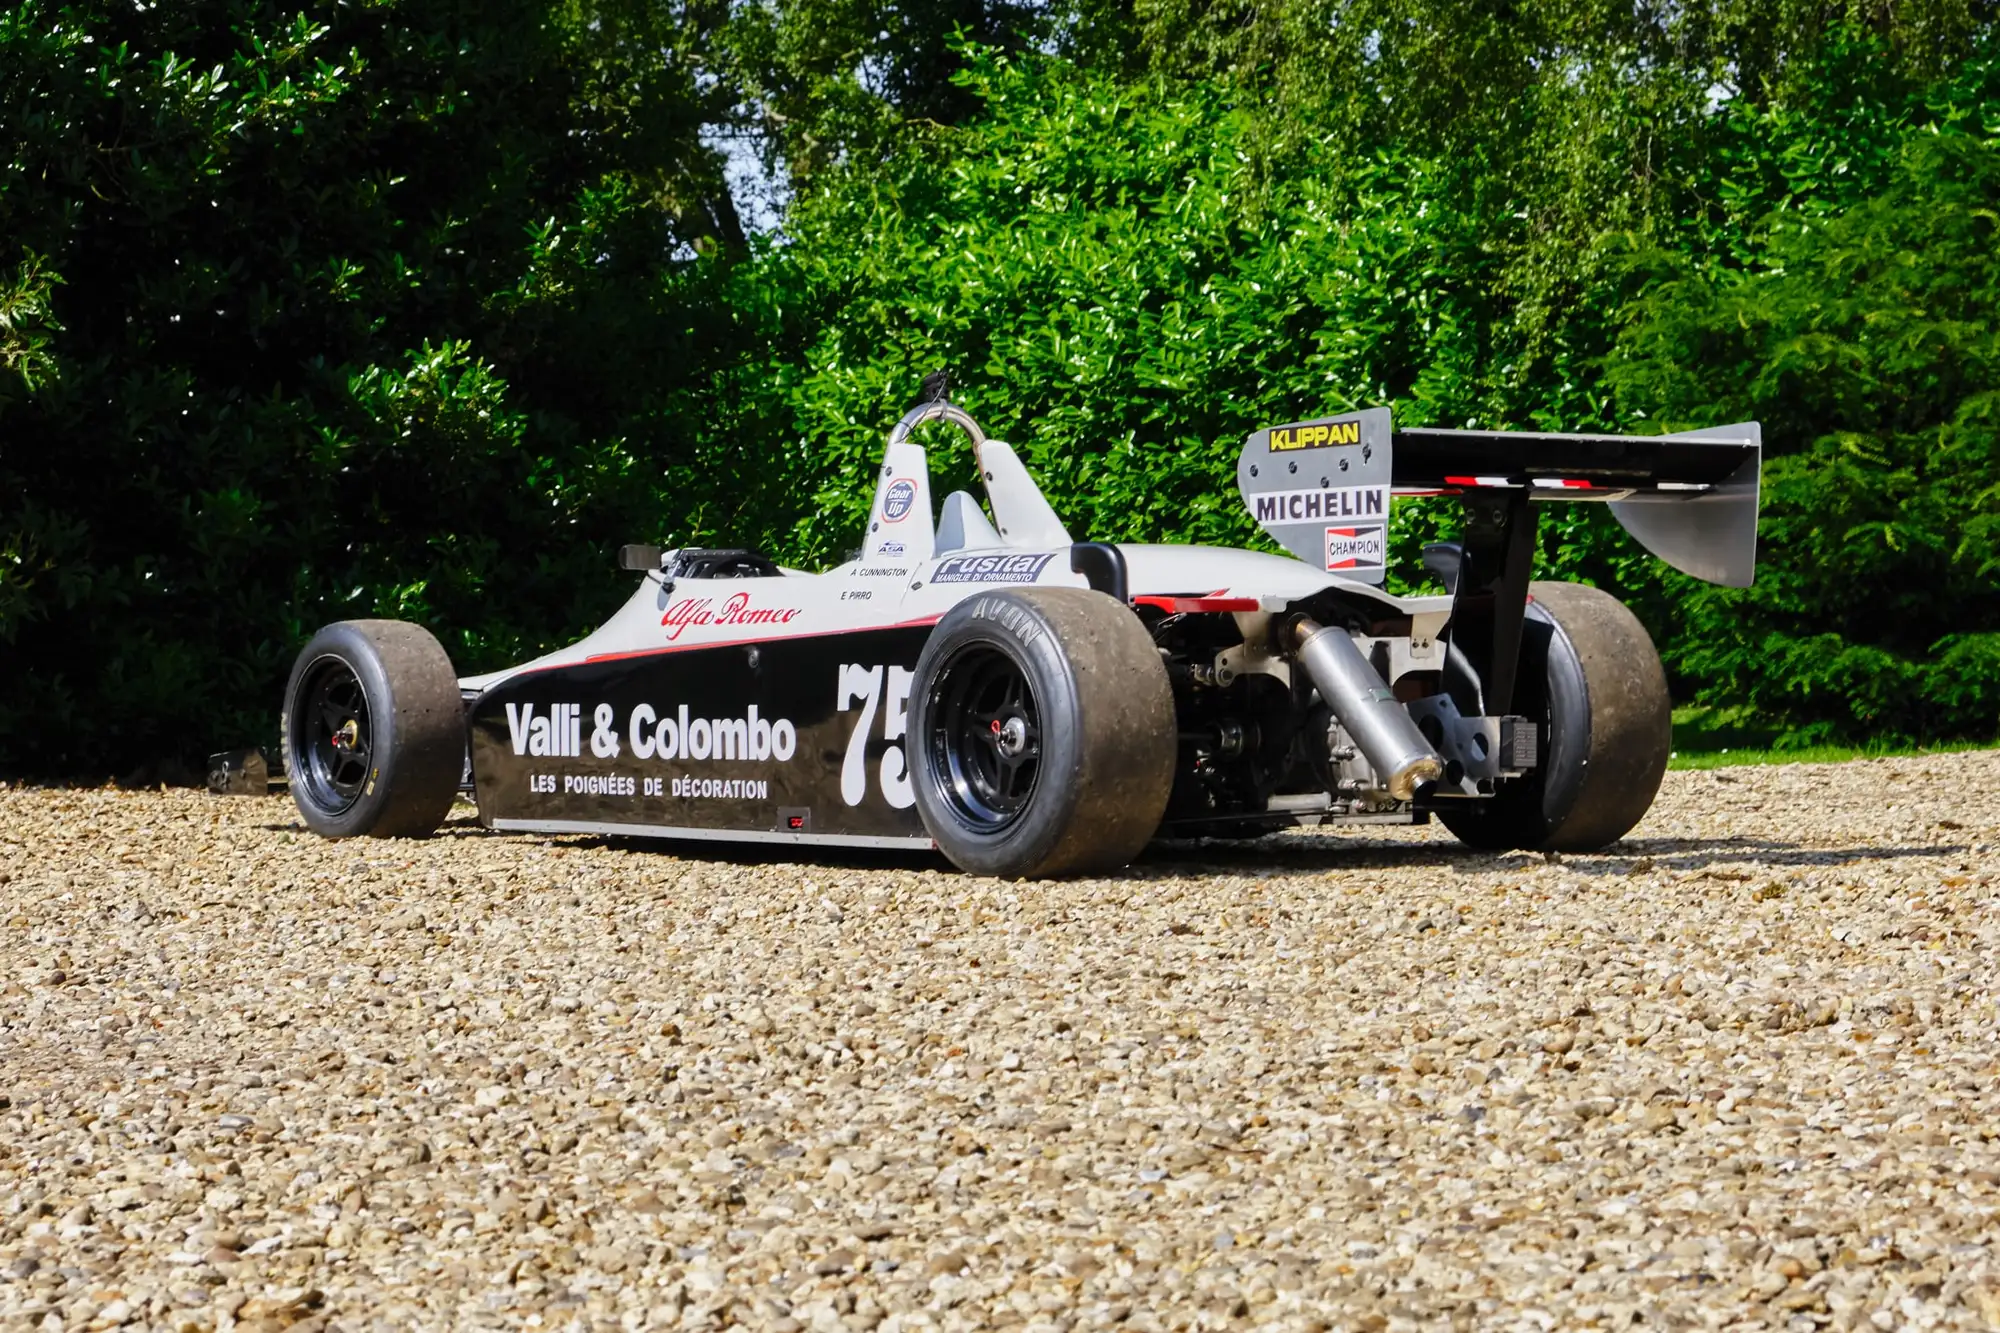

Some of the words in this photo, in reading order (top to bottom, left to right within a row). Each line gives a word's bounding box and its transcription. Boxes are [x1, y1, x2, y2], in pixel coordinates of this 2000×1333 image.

[1270, 422, 1359, 451] KLIPPAN
[887, 488, 912, 499] Gear
[1257, 489, 1382, 521] MICHELIN
[887, 502, 904, 516] Up
[1329, 541, 1380, 556] CHAMPION
[850, 568, 857, 577] A
[859, 567, 908, 577] CUNNINGTON
[940, 554, 1046, 573] Fusital
[935, 572, 971, 583] MANIGLIE
[972, 572, 982, 583] DI
[983, 572, 1033, 583] ORNAMENTO
[840, 592, 847, 600] E
[849, 591, 872, 600] PIRRO
[661, 598, 714, 641] Alfa
[714, 592, 802, 625] Romeo
[971, 598, 1042, 648] AVON
[505, 702, 581, 757] Valli
[590, 702, 621, 759] &
[629, 703, 797, 762] Colombo
[837, 663, 917, 809] 75
[530, 774, 557, 793] LES
[564, 772, 635, 797] POIGNÉES
[643, 777, 664, 797] DE
[672, 774, 768, 800] DÉCORATION
